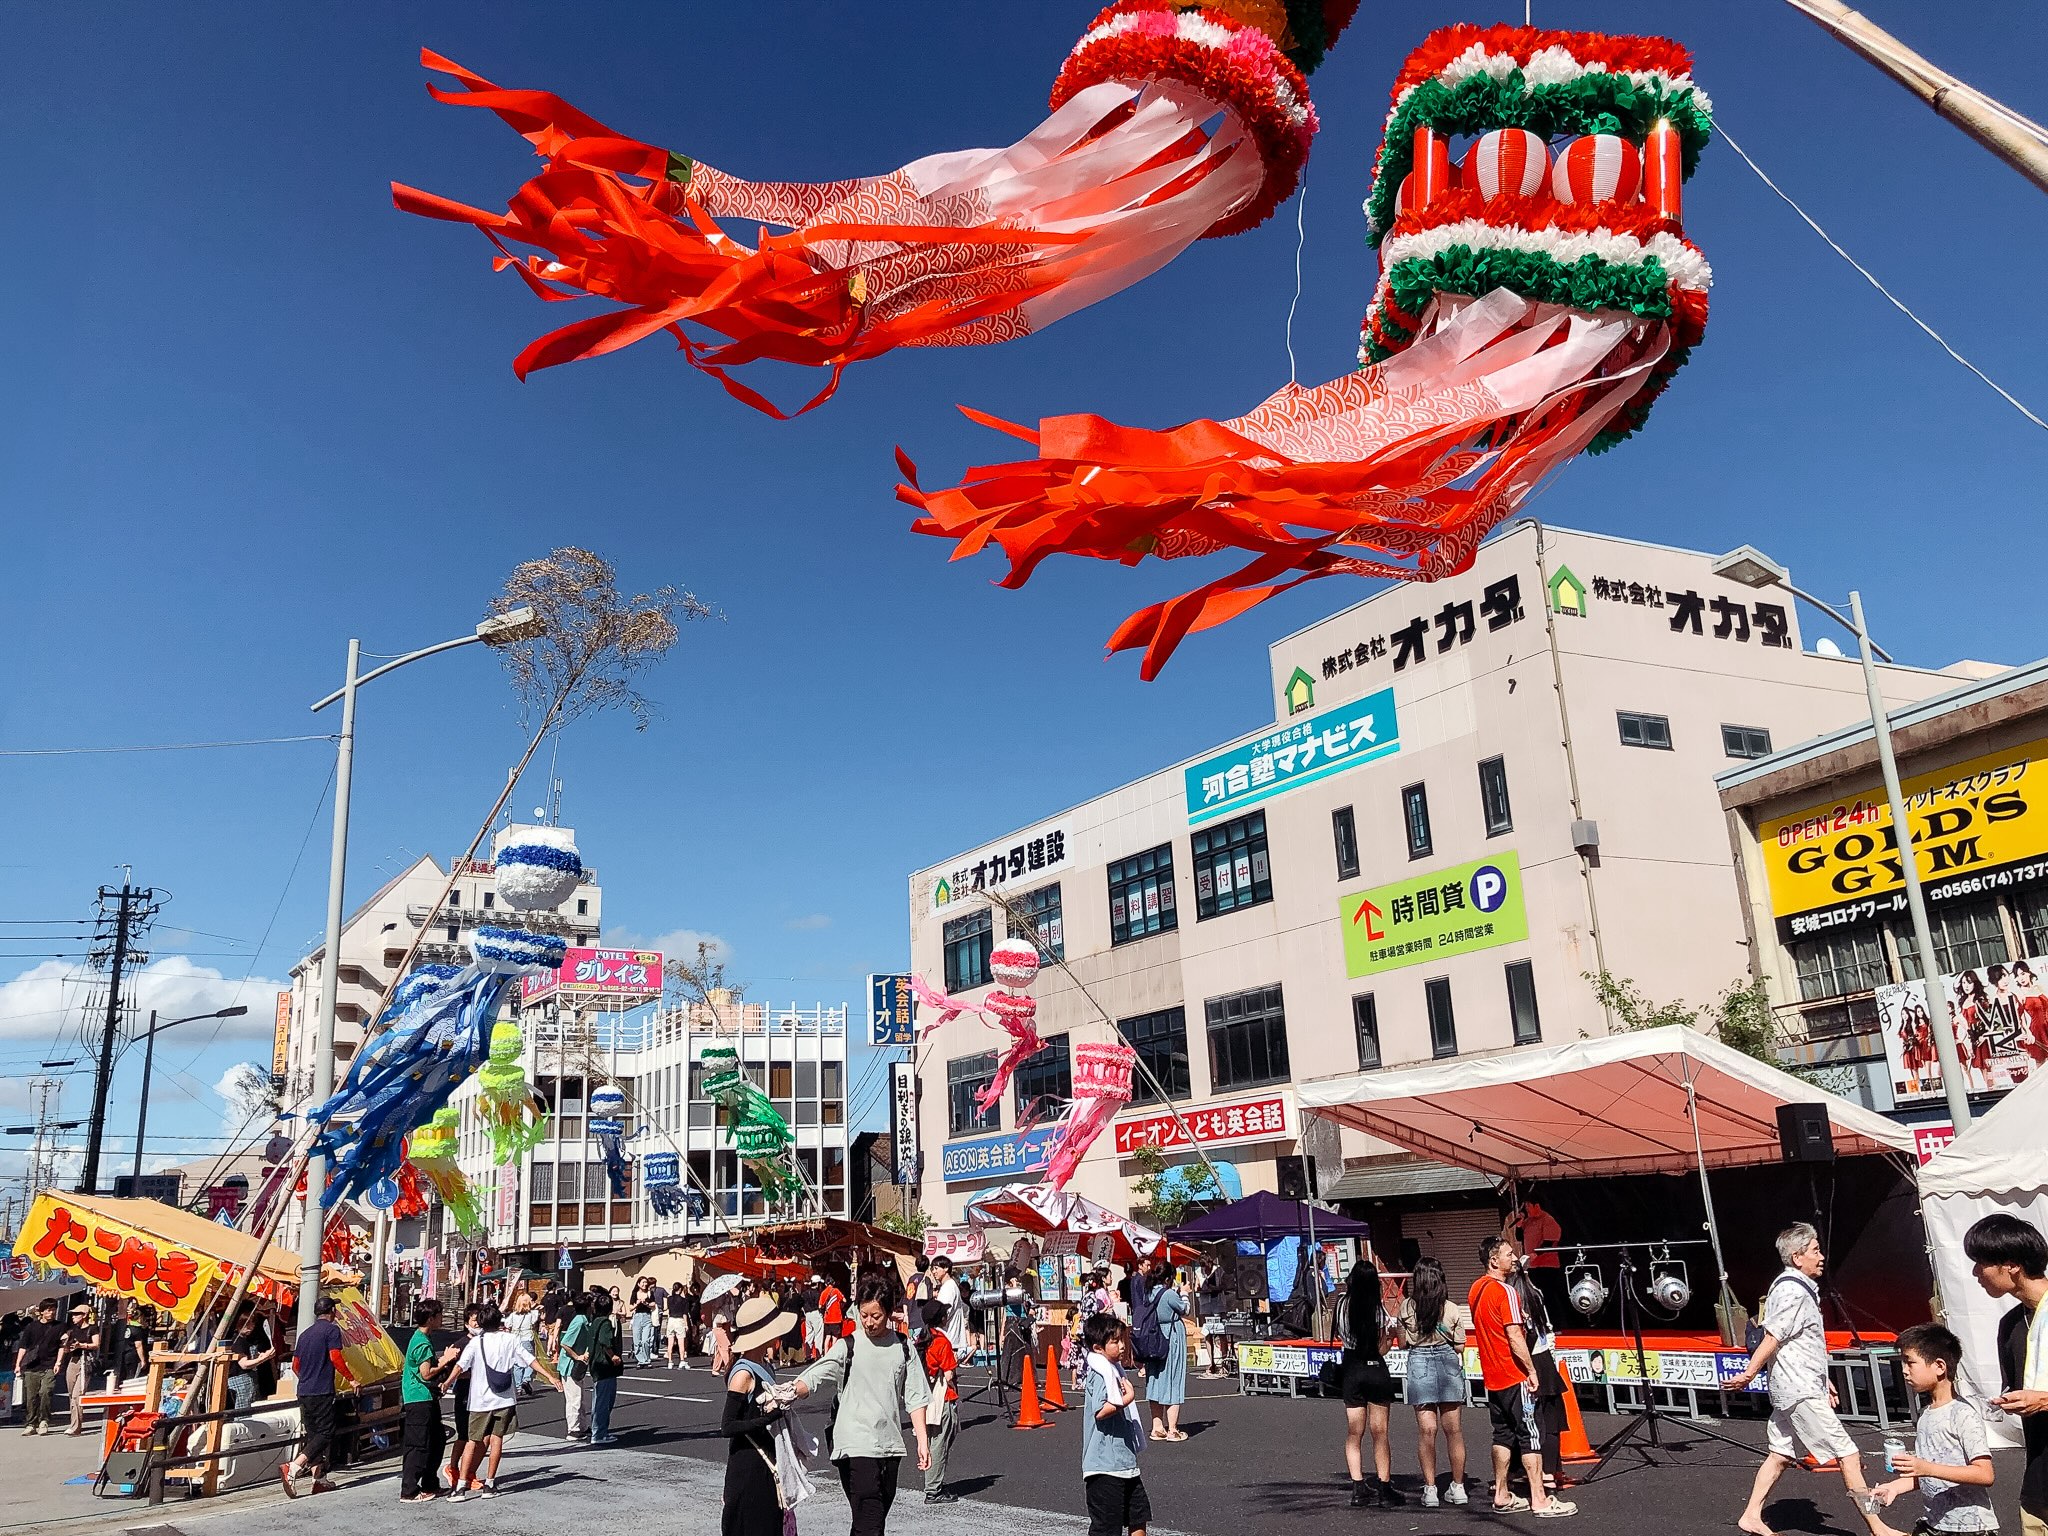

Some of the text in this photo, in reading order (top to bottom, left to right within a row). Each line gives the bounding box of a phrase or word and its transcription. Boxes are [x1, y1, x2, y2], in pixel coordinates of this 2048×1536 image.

[1202, 714, 1377, 803] 河合塾マナビス
[1252, 723, 1313, 756] 大学現役合格
[1778, 758, 2031, 847] OPEN 24h ィットネスクラブ
[1788, 789, 2028, 874] GOLD'S
[971, 830, 1065, 893] オカダ建設
[1832, 835, 1986, 894] GYM
[1114, 888, 1172, 919] 無料講習
[1391, 881, 1466, 925] 時間貸
[1791, 894, 1907, 936] 安城コロナワール
[595, 951, 629, 960] HOTEL
[1369, 923, 1495, 962] 駐車場営業時間 24時間営業
[575, 959, 648, 985] グレイス
[875, 976, 892, 1044] イーオン
[1120, 1103, 1282, 1150] イーオンこども英会話
[978, 1138, 1053, 1169] 英会話イーオ
[33, 1207, 198, 1308] たこやき
[1274, 1360, 1306, 1371] デンパーク
[1568, 1363, 1589, 1382] ign
[1663, 1368, 1714, 1382] デンパーク
